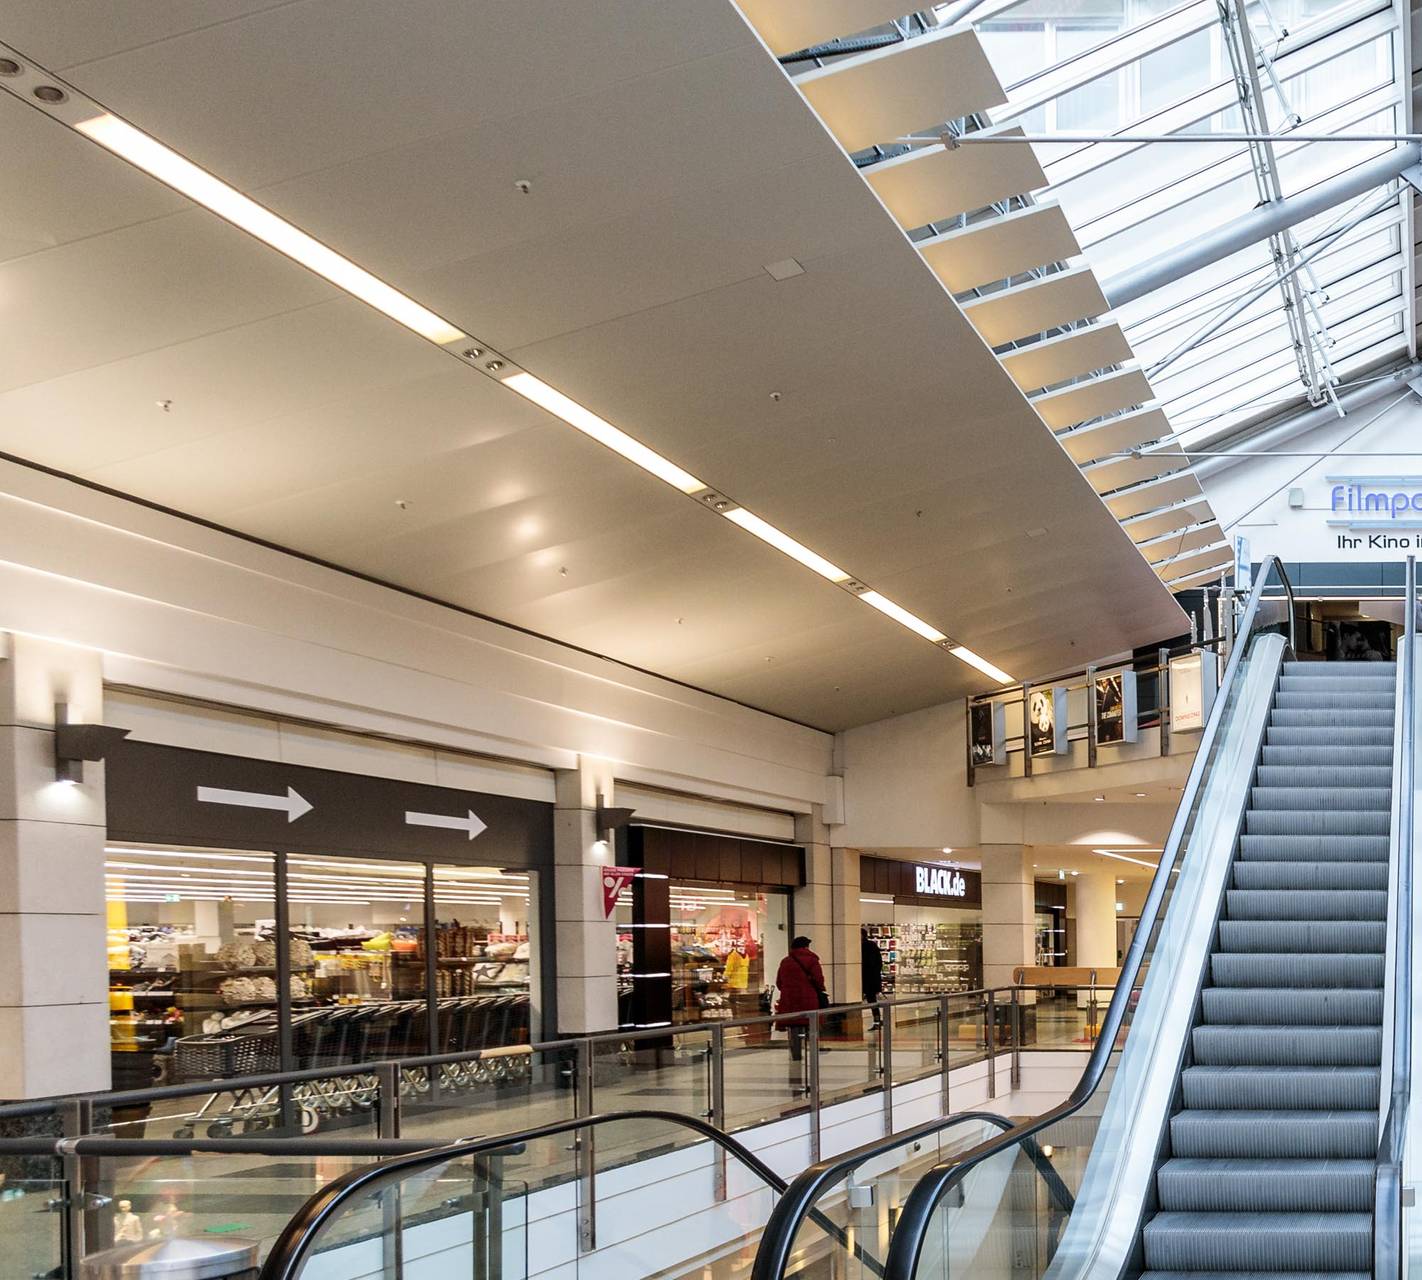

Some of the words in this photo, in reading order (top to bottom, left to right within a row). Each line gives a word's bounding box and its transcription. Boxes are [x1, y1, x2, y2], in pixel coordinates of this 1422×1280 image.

[1337, 535, 1362, 549] Ihr
[1368, 534, 1410, 549] Kino
[915, 866, 966, 897] BLACK.de
